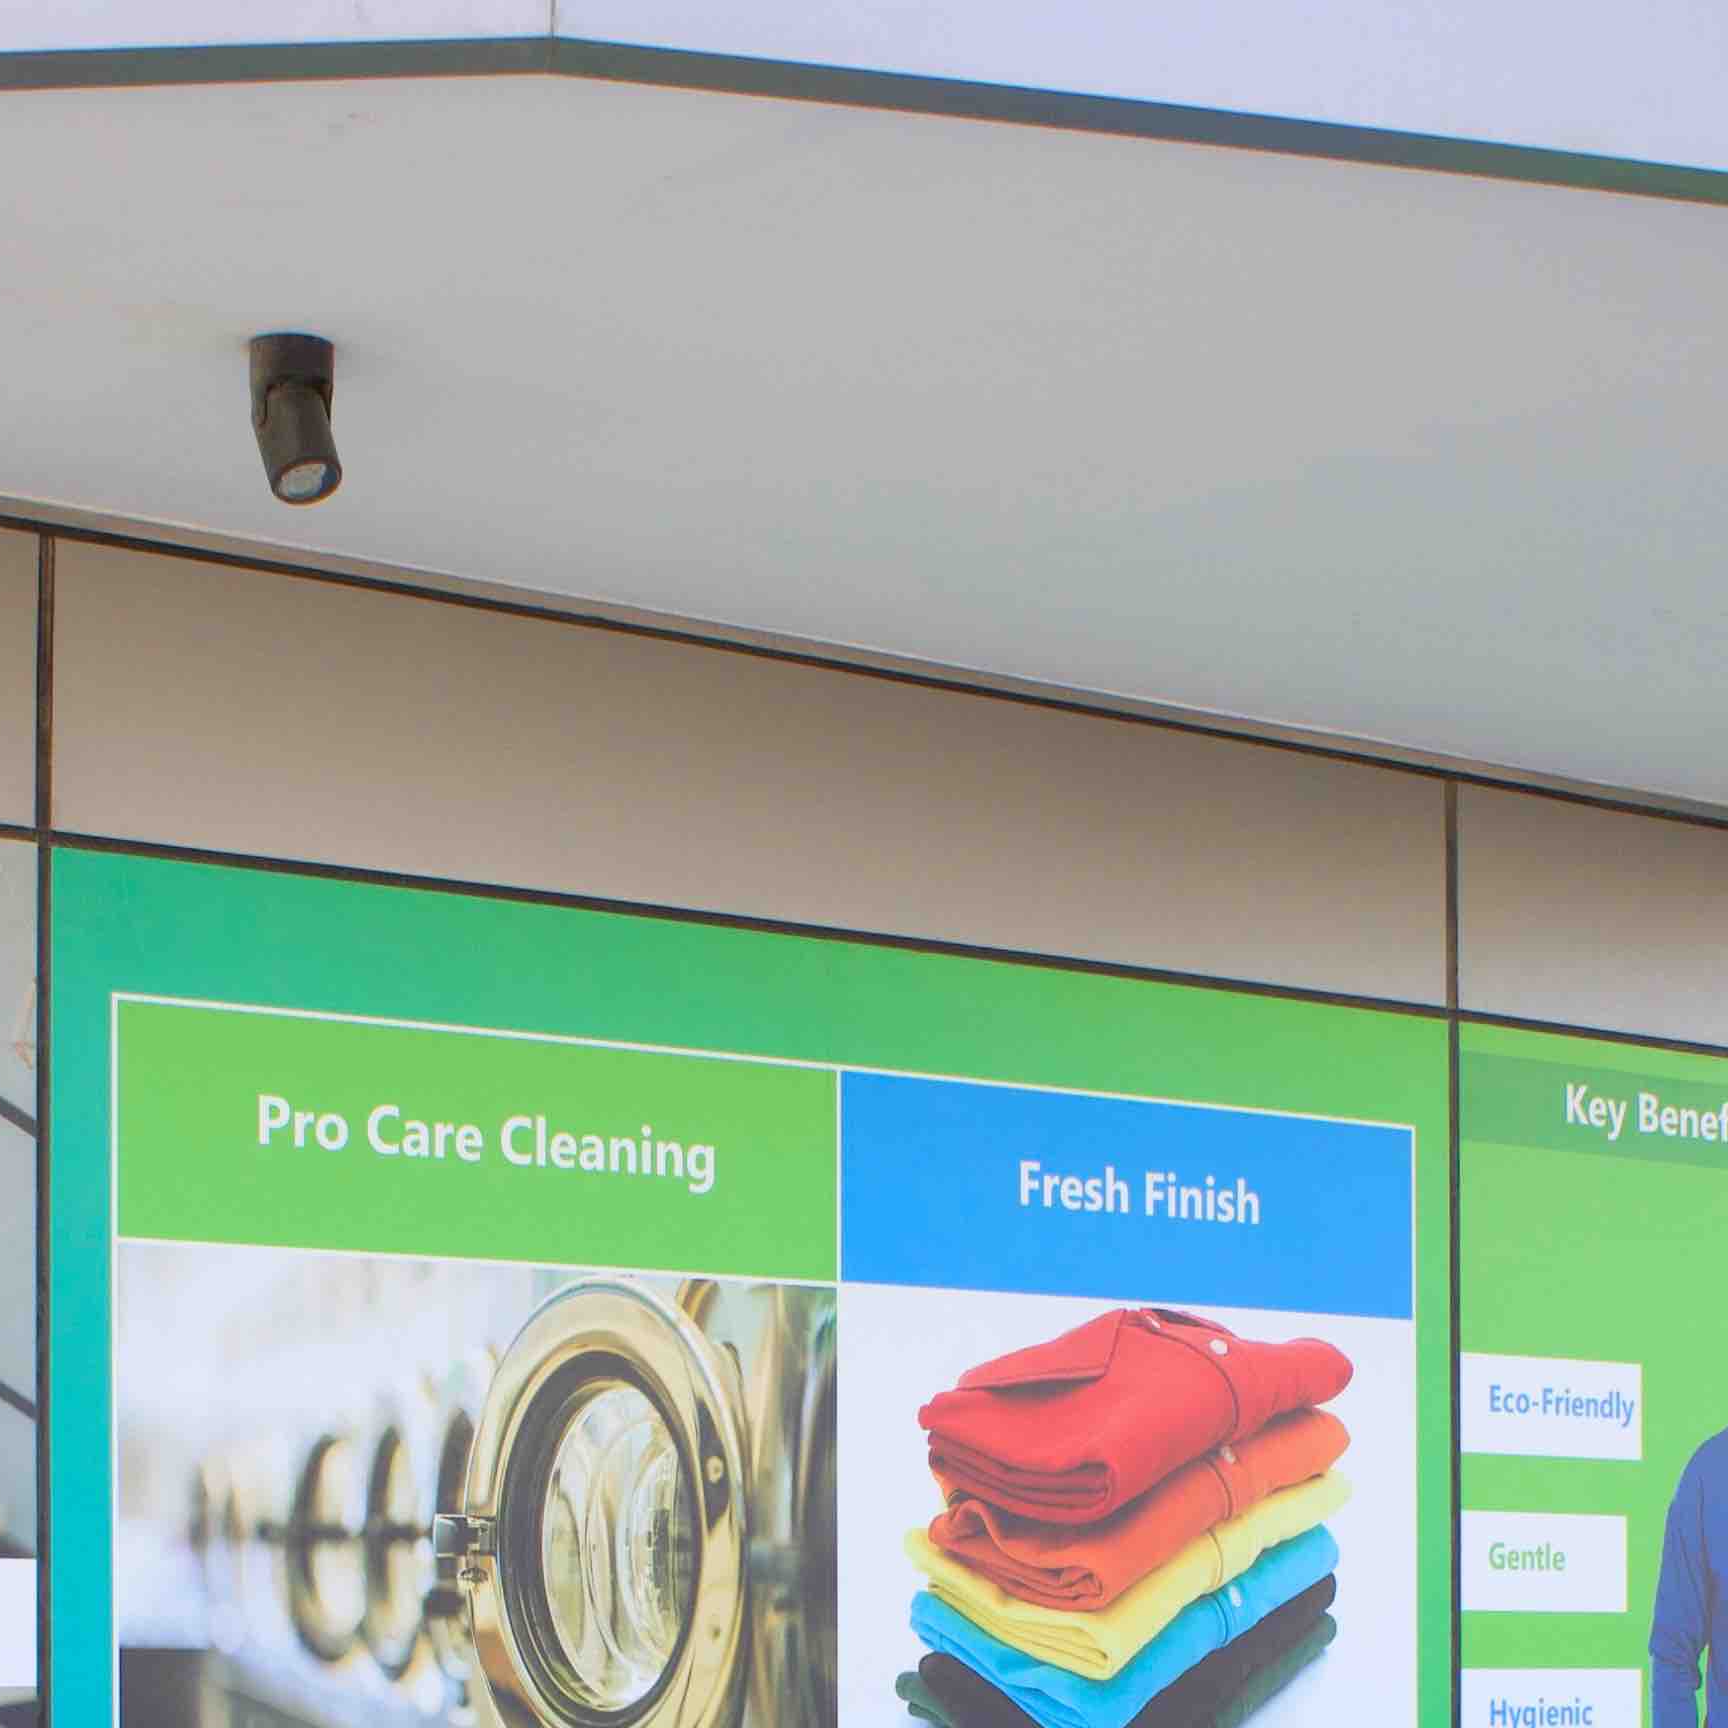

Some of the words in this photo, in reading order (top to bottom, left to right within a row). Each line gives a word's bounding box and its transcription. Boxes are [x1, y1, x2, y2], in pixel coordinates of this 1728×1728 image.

[1564, 1083, 1626, 1141] Key
[257, 1093, 350, 1153] Pro
[366, 1104, 484, 1163] Care
[500, 1113, 717, 1195] Cleaning
[1018, 1159, 1130, 1215] Fresh
[1144, 1170, 1262, 1226] Finish
[1488, 1384, 1635, 1429] Eco-Friendly
[1488, 1542, 1566, 1573] Gentle
